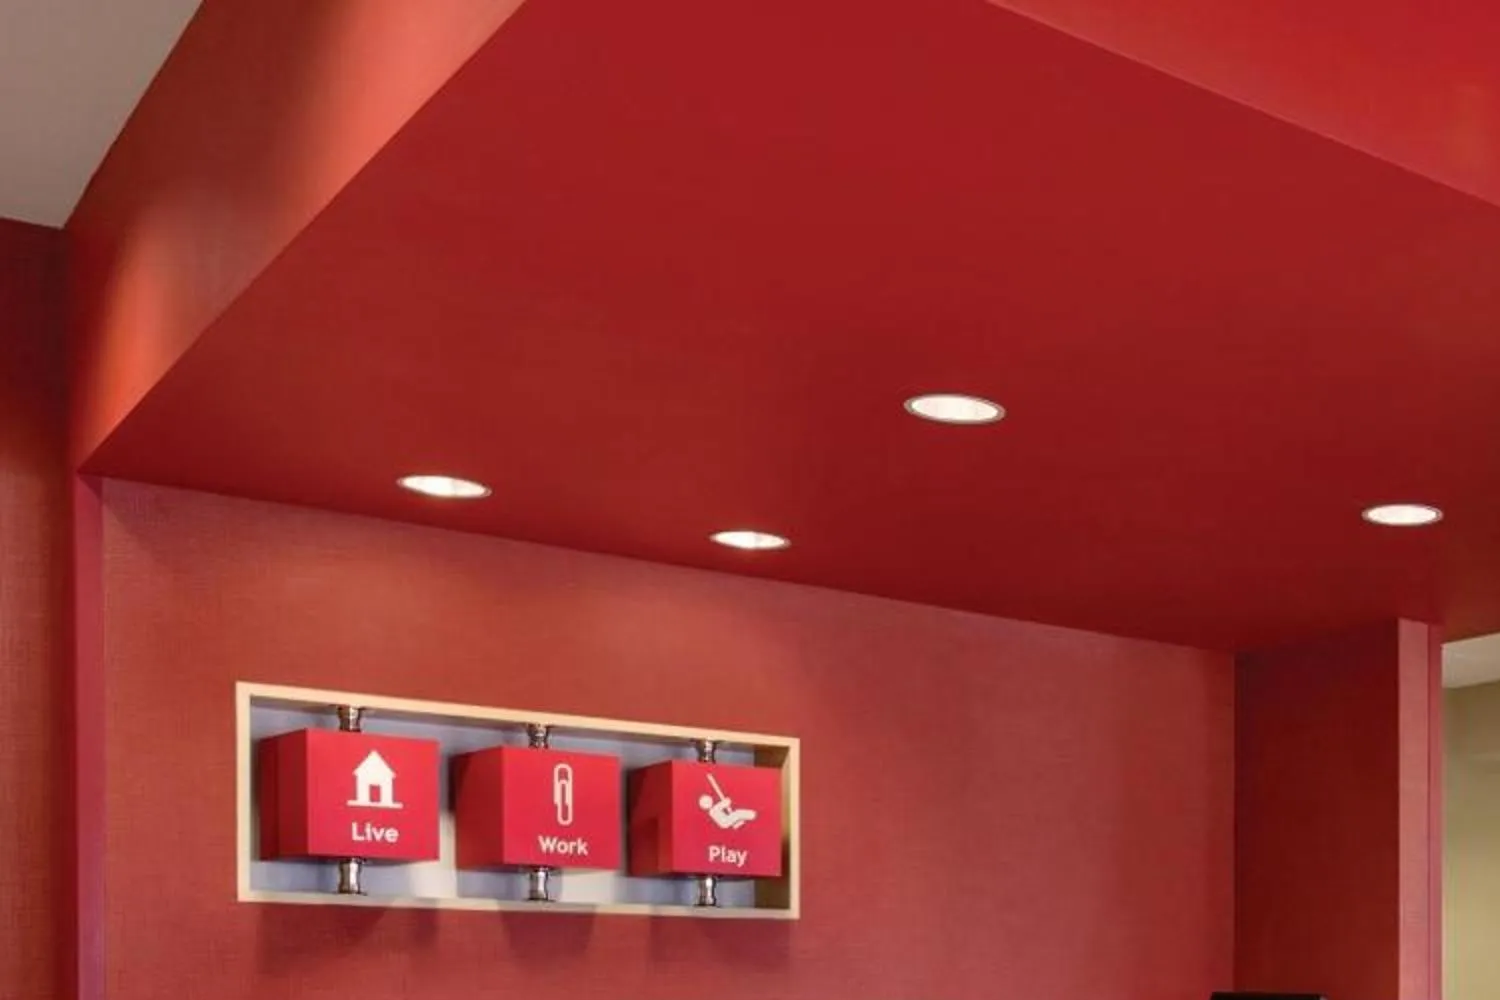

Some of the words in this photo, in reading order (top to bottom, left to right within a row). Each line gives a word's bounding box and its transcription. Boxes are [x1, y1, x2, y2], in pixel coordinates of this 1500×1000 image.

[351, 821, 399, 843] Live
[537, 835, 589, 856] Work
[708, 845, 748, 868] Play
